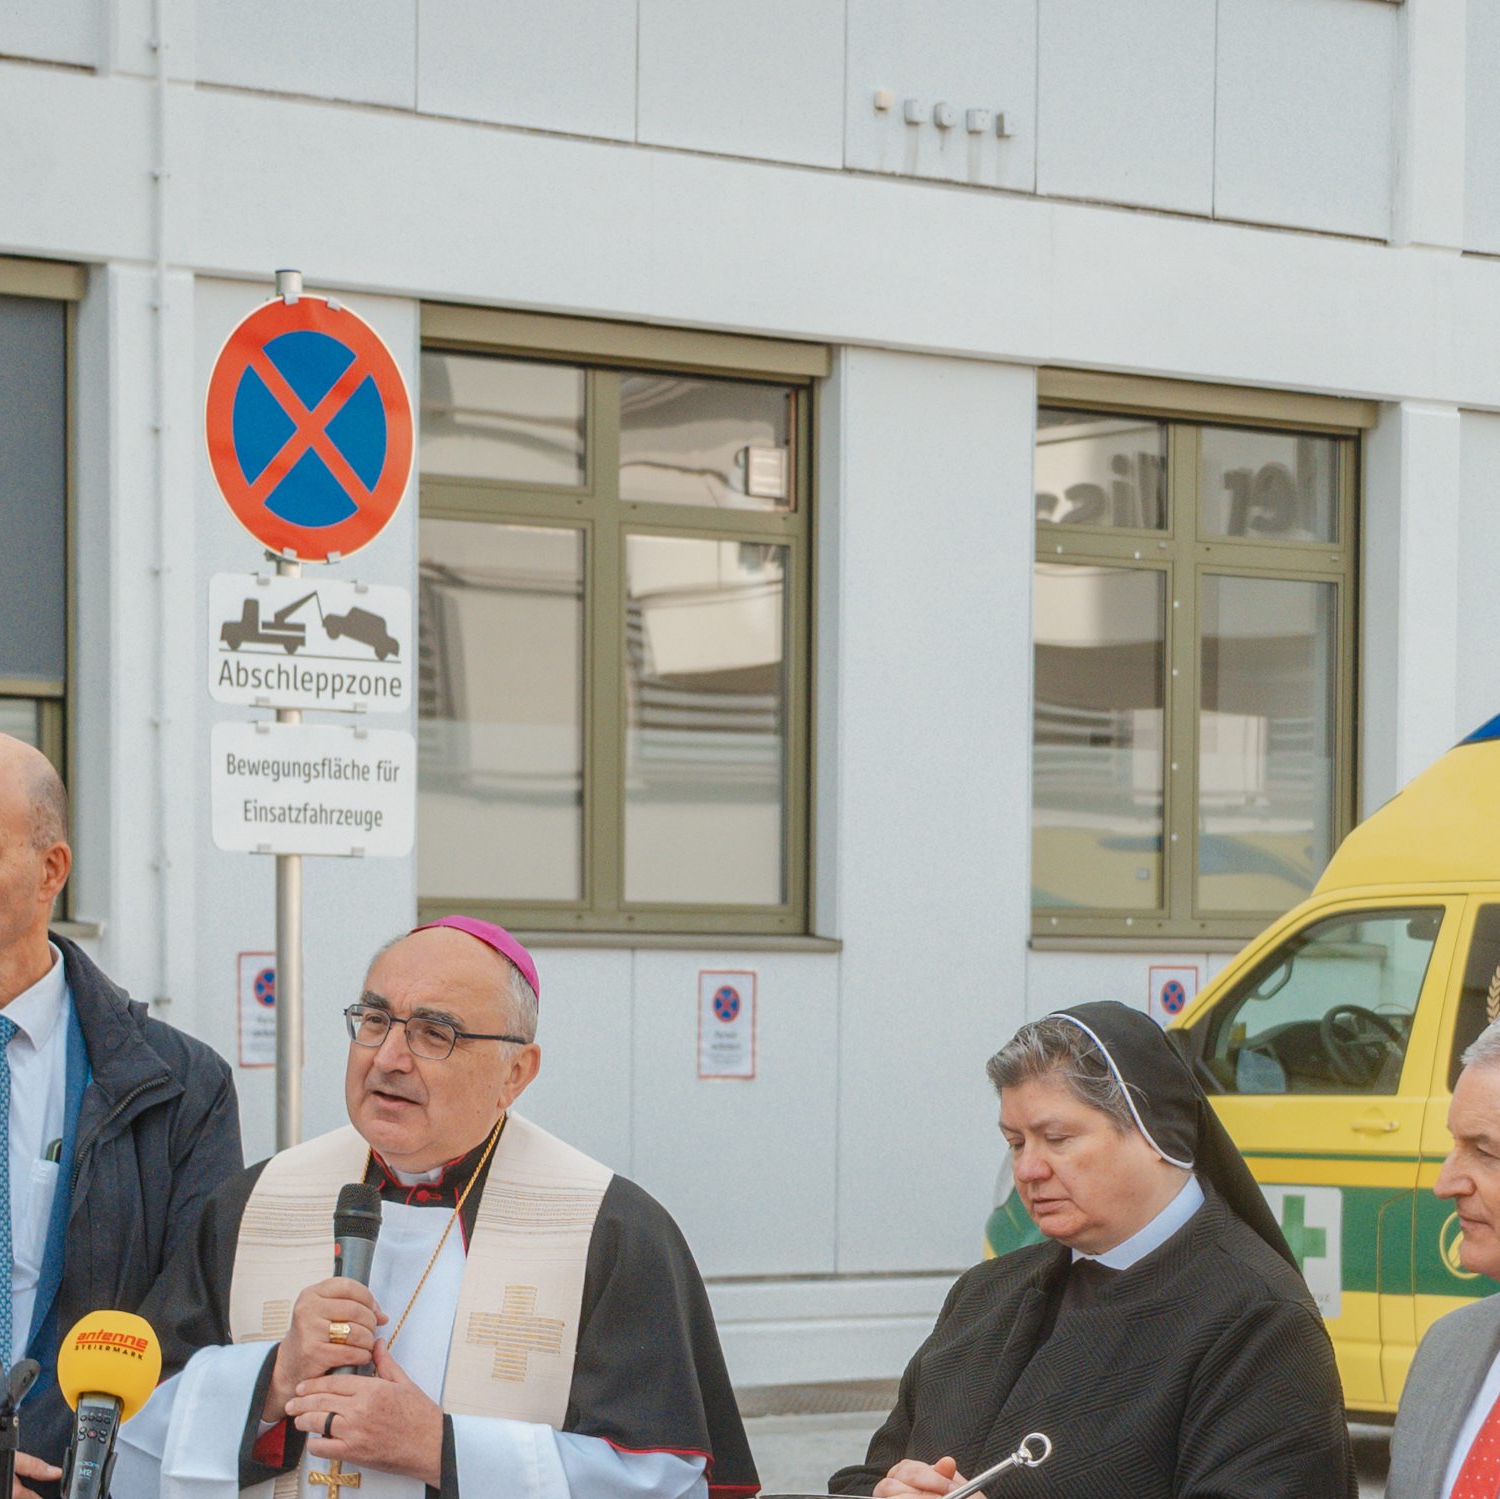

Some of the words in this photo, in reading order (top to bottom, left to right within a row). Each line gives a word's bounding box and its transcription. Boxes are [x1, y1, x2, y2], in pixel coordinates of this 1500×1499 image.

[218, 659, 401, 699] Abschleppzone
[226, 753, 370, 783] Bewegungsfläche
[376, 760, 400, 782] für
[243, 799, 383, 831] Einsatzfahrzeuge
[74, 1344, 144, 1361] STEIERMARK
[77, 1329, 149, 1350] antenne
